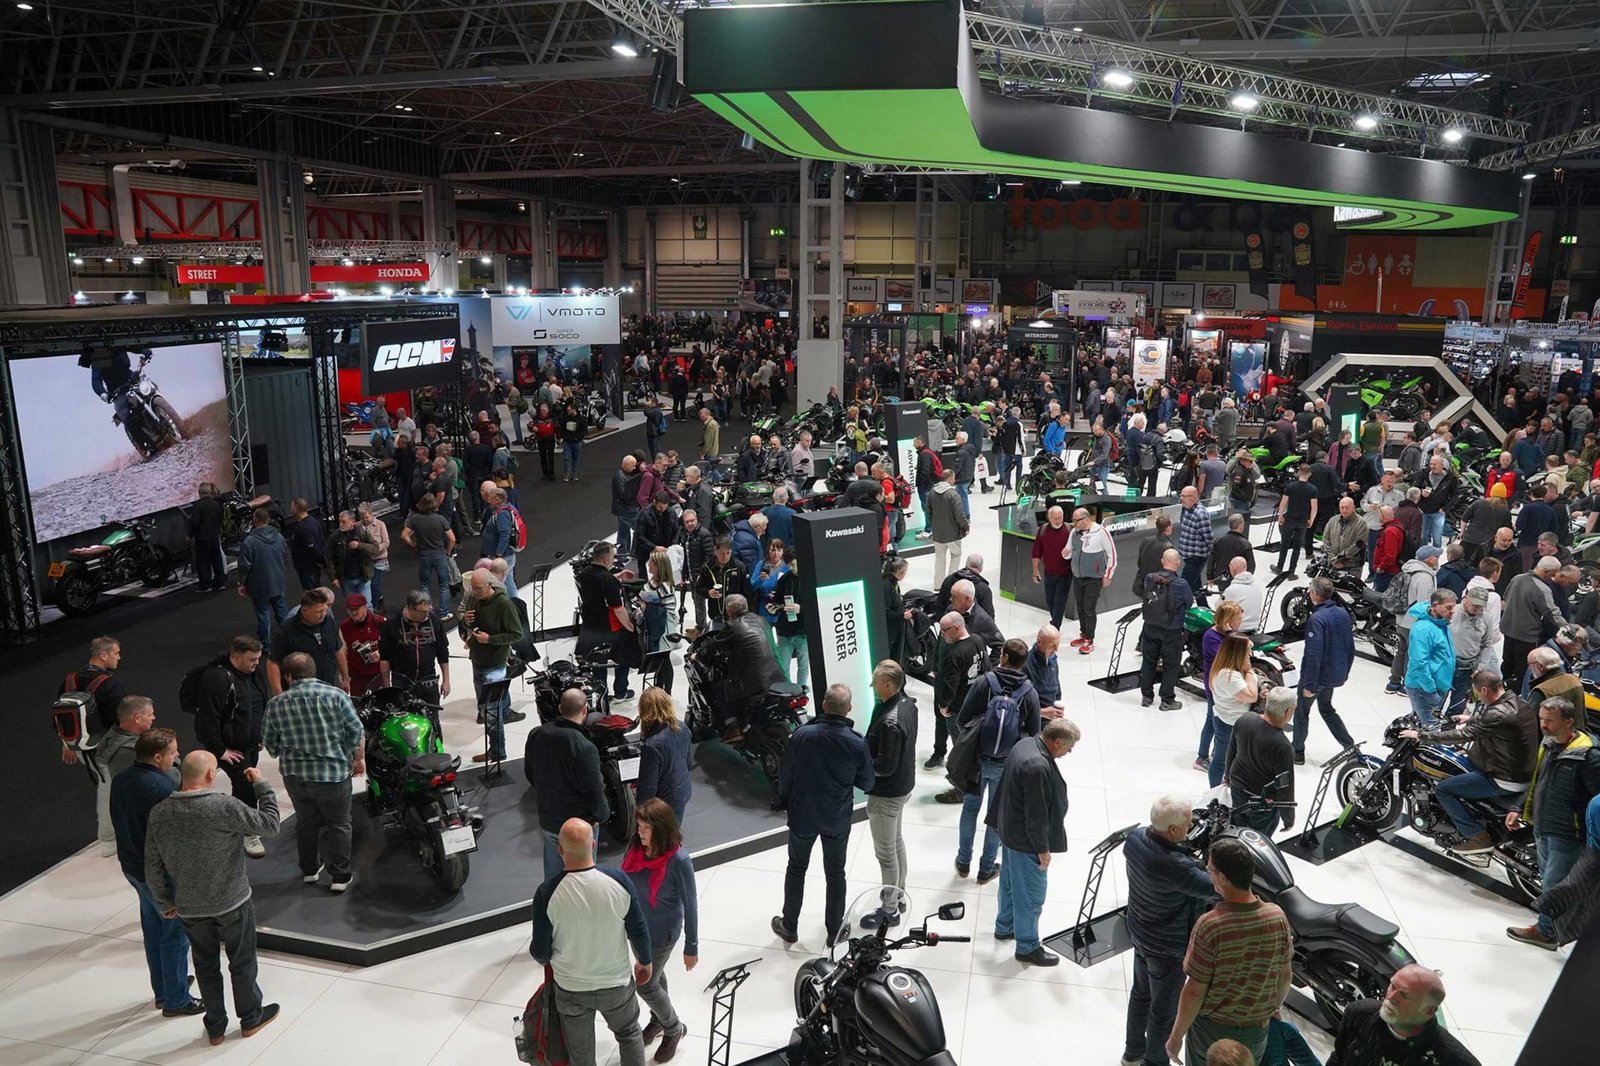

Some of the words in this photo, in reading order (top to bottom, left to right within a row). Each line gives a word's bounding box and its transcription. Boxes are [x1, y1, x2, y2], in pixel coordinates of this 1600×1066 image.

[187, 270, 218, 280] STREET
[378, 268, 423, 277] HONDA
[547, 308, 606, 316] VMOTO
[373, 339, 456, 372] CCM
[825, 525, 865, 538] Kawasaki
[833, 603, 847, 662] TOURER
[844, 602, 858, 655] SPORTS
